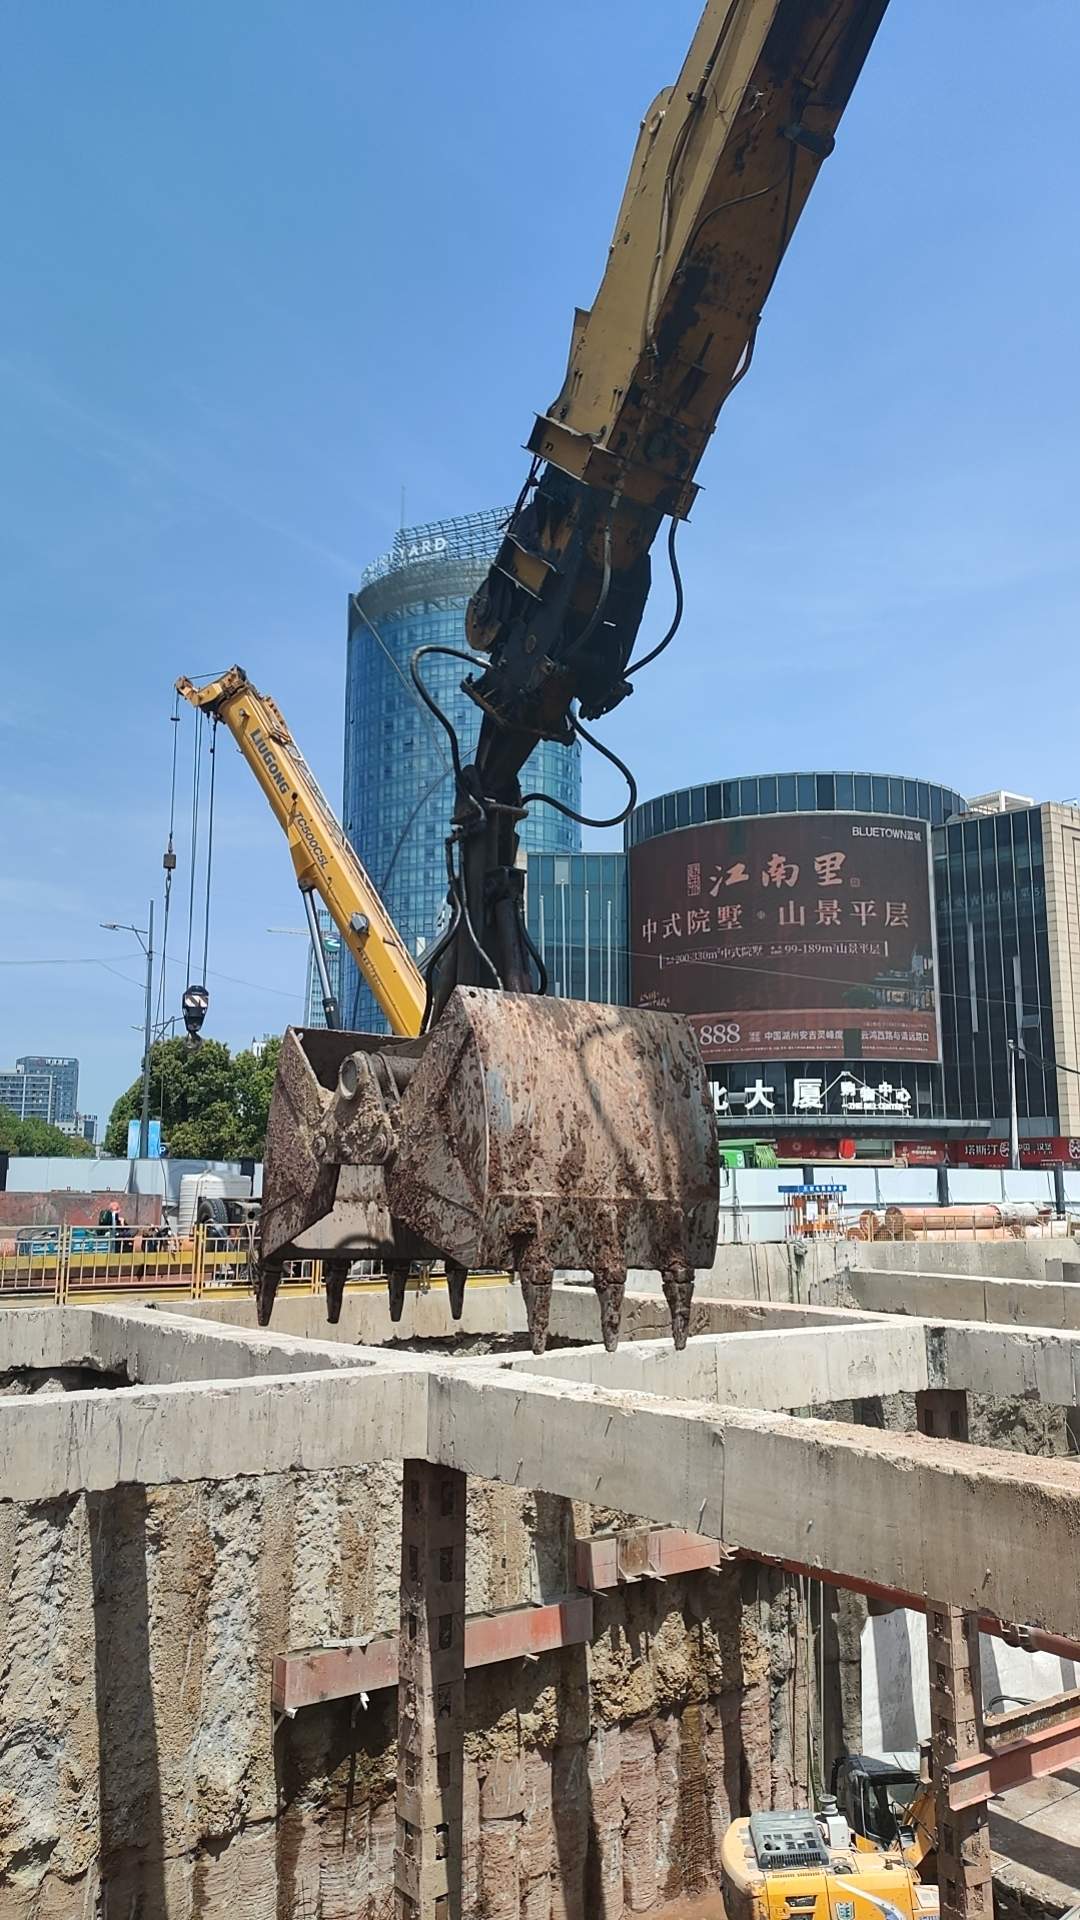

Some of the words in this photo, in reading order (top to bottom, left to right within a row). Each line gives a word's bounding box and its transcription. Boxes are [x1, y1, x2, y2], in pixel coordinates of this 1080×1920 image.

[250, 728, 290, 794] LIUGONG
[852, 826, 907, 840] BLUETOWN
[708, 851, 847, 897] 江南里
[641, 903, 743, 944] 中式院墅
[778, 899, 910, 929] 山景平层
[699, 1023, 741, 1045] 888
[159, 1146, 166, 1155] P
